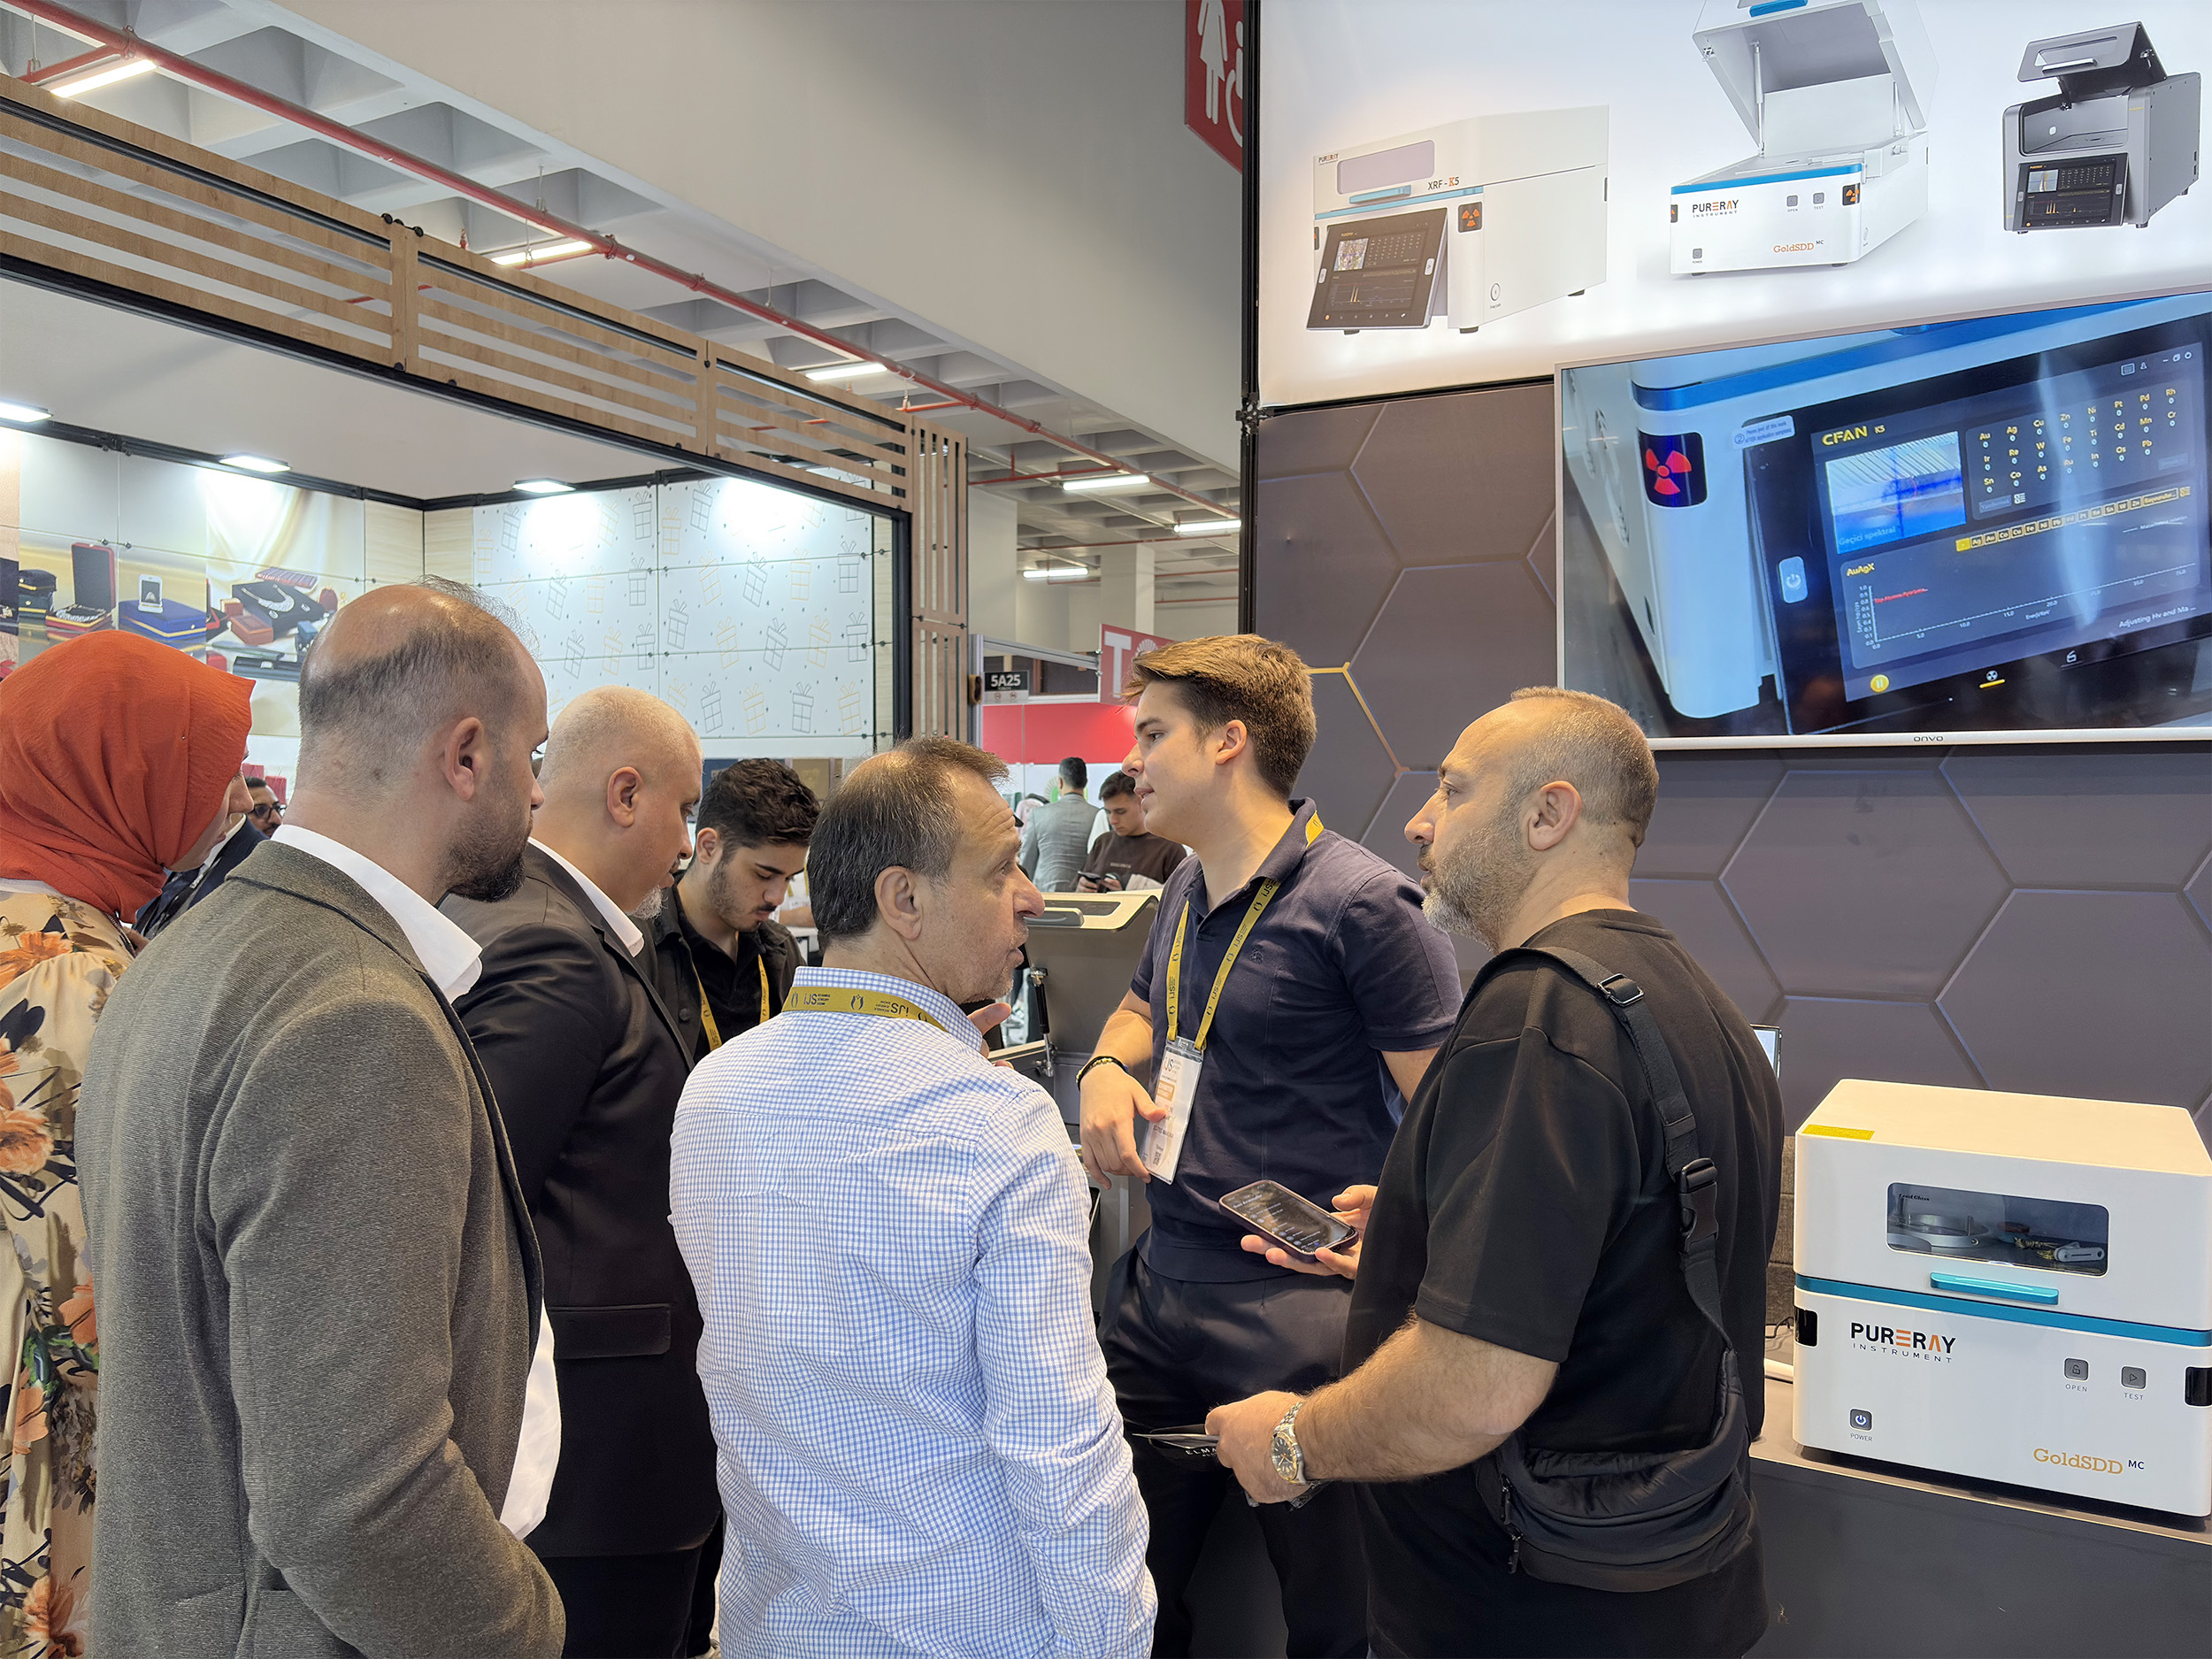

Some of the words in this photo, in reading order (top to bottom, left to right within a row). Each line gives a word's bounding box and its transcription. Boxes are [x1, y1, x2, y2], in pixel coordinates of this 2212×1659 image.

[1428, 180, 1443, 190] XRF
[1448, 176, 1460, 187] K5
[1692, 199, 1739, 213] PURERAY
[1693, 210, 1738, 219] INSTRUMENT
[1773, 242, 1815, 253] GoldSDD
[2006, 426, 2017, 434] Ag
[2139, 393, 2150, 402] Pd
[2165, 388, 2176, 396] Rh
[2114, 422, 2125, 431] Cd
[1822, 426, 1868, 446] CFAN
[1864, 526, 1896, 541] spektral
[1847, 563, 1875, 576] AuAgX
[2119, 616, 2152, 628] Adjusting
[991, 674, 1021, 687] 5A25
[1851, 1322, 1956, 1354] PURERAY
[1853, 1343, 1952, 1363] INSTRUMENT
[2065, 1383, 2088, 1393] OPEN
[2124, 1392, 2144, 1401] TEST
[1850, 1432, 1873, 1442] POWER
[2033, 1448, 2124, 1475] GoldSDD
[2128, 1459, 2145, 1470] MC
